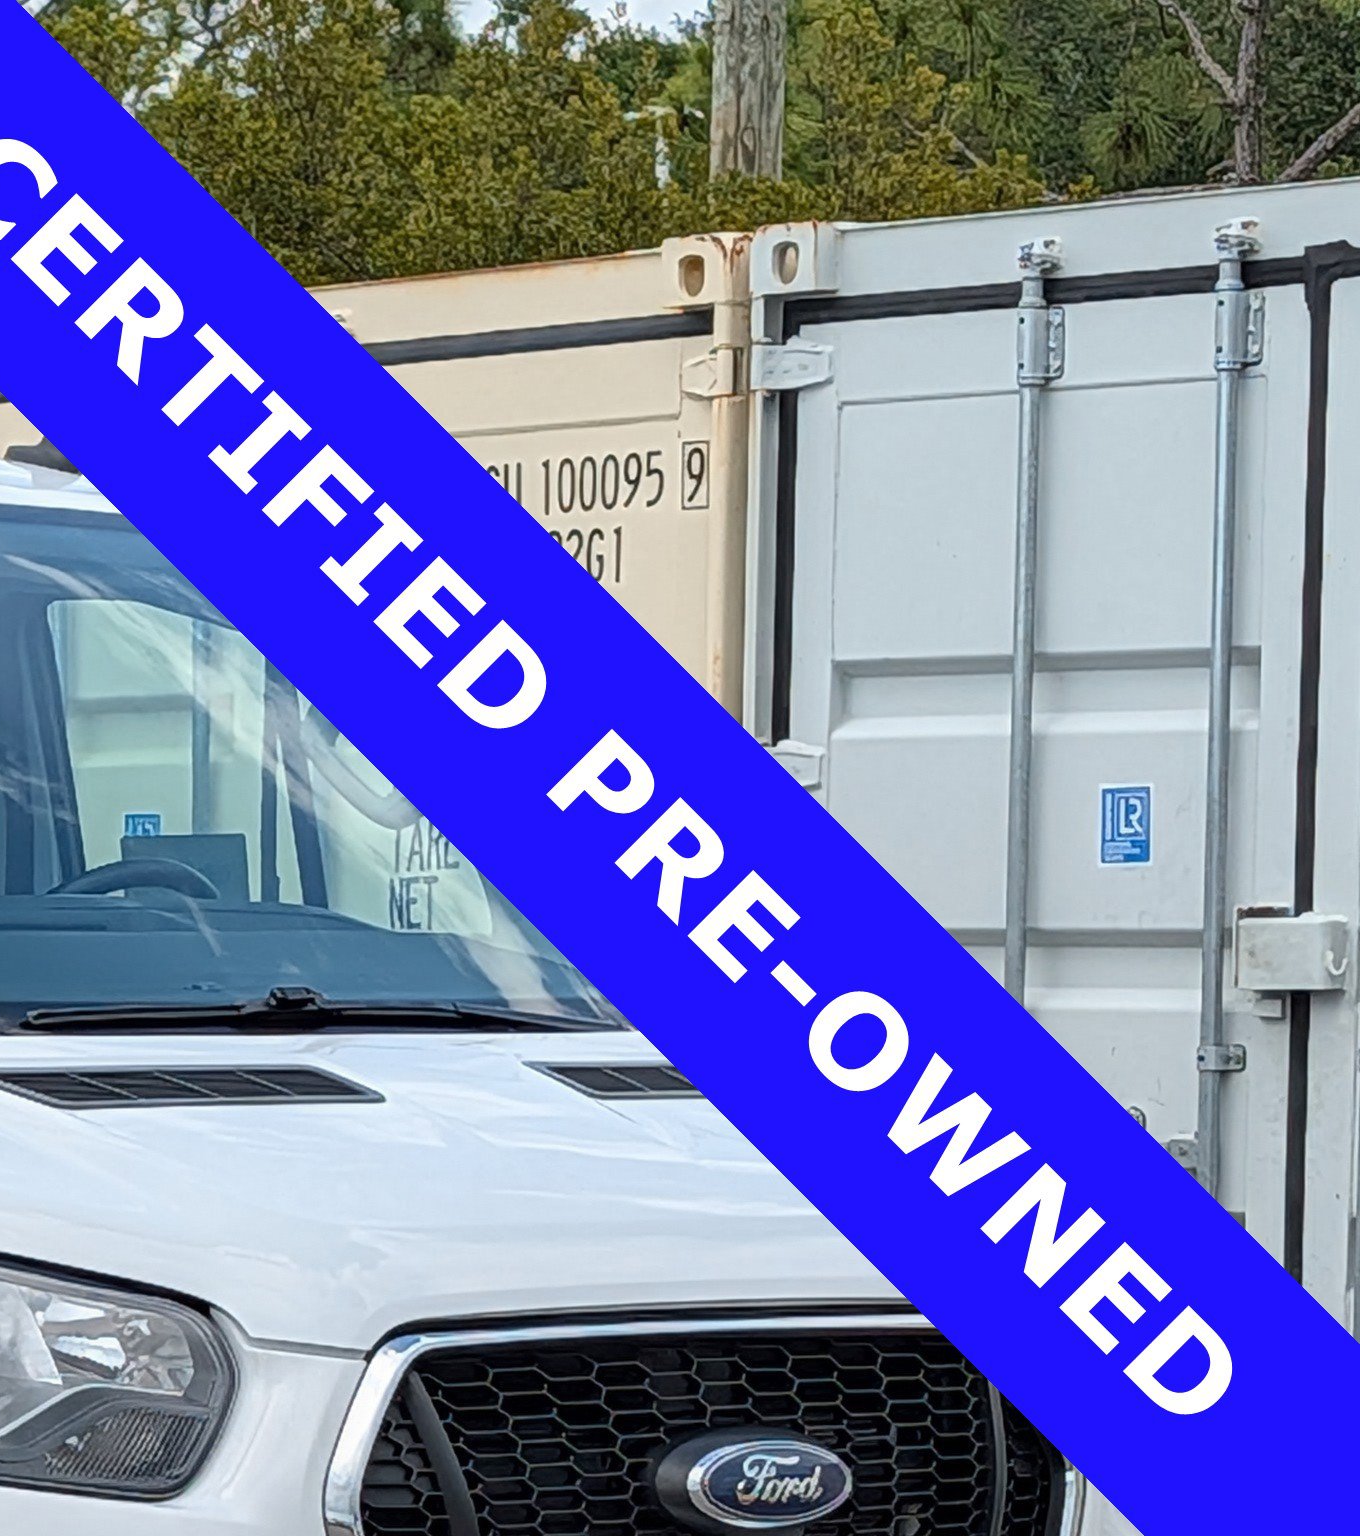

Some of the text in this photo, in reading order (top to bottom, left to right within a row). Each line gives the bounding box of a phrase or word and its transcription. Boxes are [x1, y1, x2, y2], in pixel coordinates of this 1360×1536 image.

[541, 449, 666, 517] 100095
[686, 446, 705, 503] 9
[547, 525, 623, 584] 2G1
[389, 875, 440, 932] NET
[735, 1453, 825, 1506] Ford
